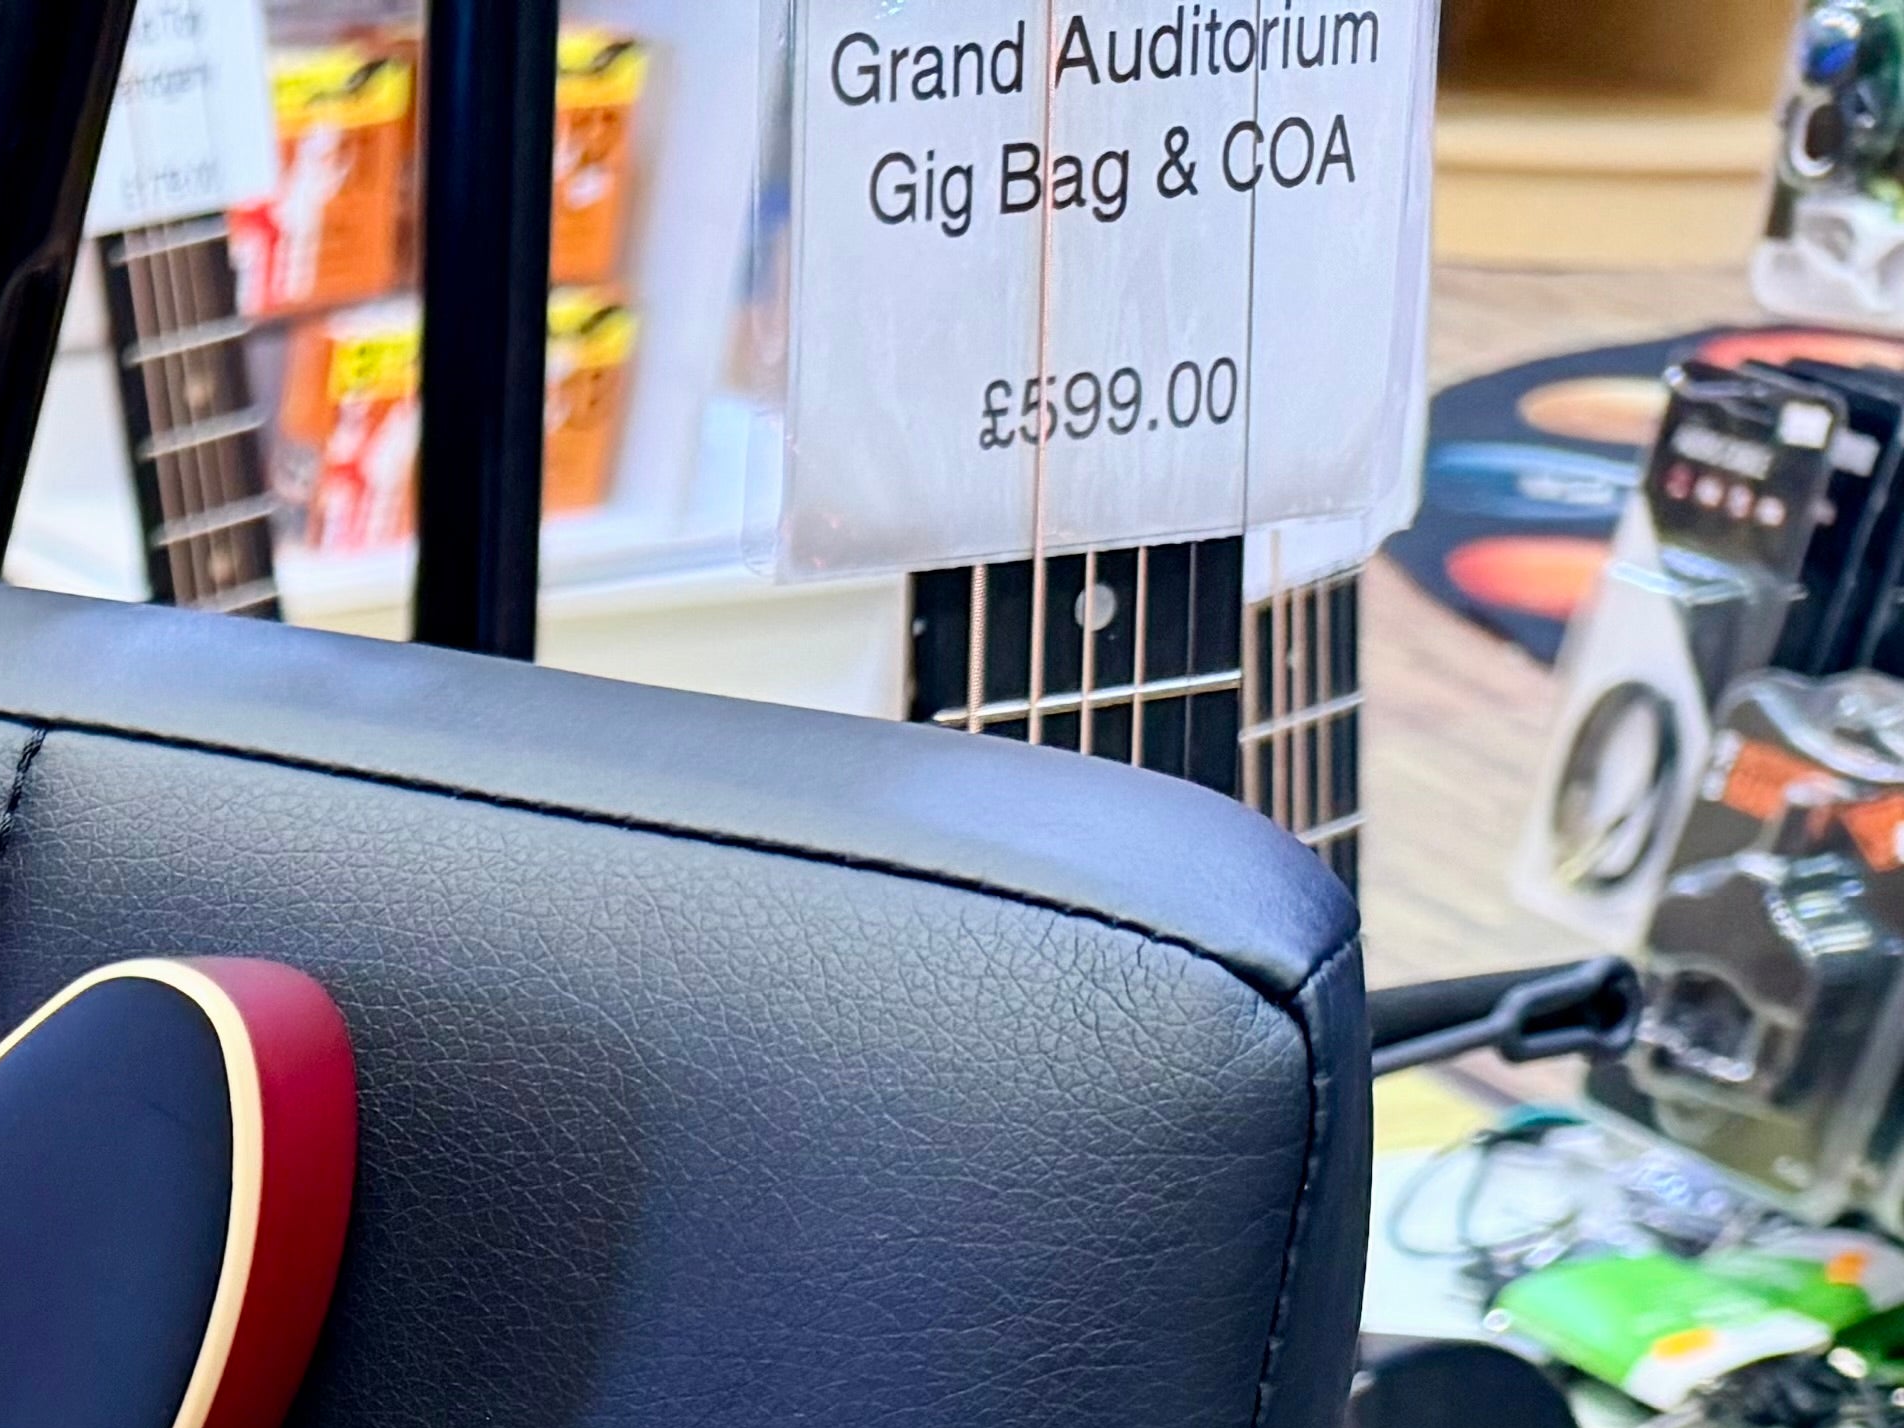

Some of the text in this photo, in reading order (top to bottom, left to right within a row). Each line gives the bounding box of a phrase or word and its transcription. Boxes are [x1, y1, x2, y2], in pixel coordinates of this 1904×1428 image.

[830, 0, 1381, 107] Grand Auditorium
[868, 113, 1357, 238] Gig Bag & COA
[978, 355, 1238, 451] £599.00
